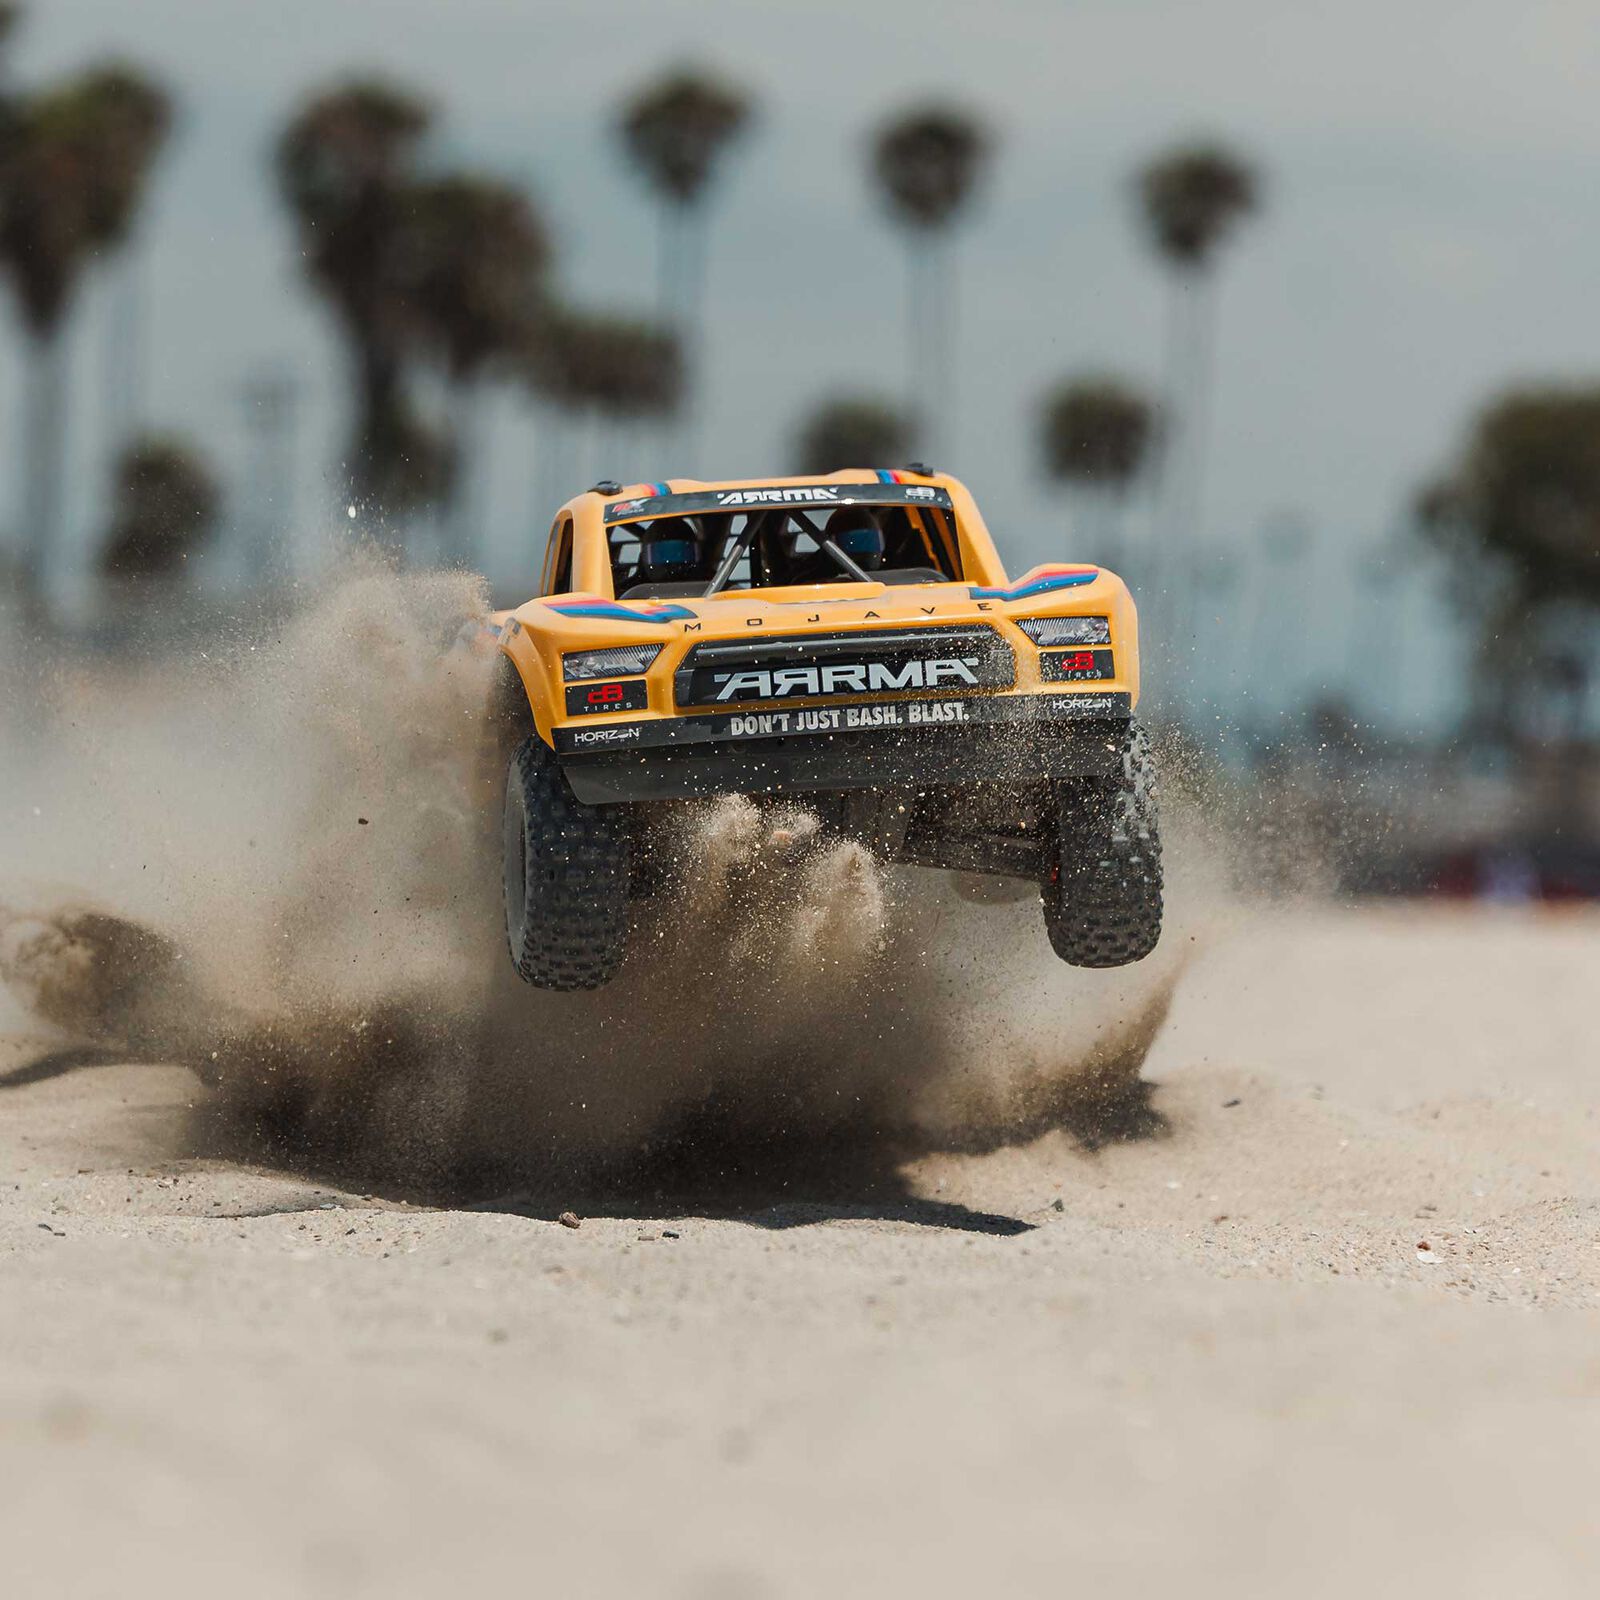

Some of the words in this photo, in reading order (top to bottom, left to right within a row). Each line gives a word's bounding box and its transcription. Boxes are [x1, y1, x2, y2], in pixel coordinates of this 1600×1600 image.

[717, 486, 839, 505] ARRMA
[684, 602, 993, 633] MOJAVE
[714, 657, 979, 700] ARRMA
[587, 684, 624, 704] dB
[1052, 698, 1112, 709] HORIZON
[583, 702, 633, 712] TIRES
[731, 714, 791, 736] DON'T
[796, 709, 841, 731] JUST
[847, 704, 903, 726] BASH.
[909, 702, 970, 723] BLAST.
[574, 727, 640, 743] HORIZON
